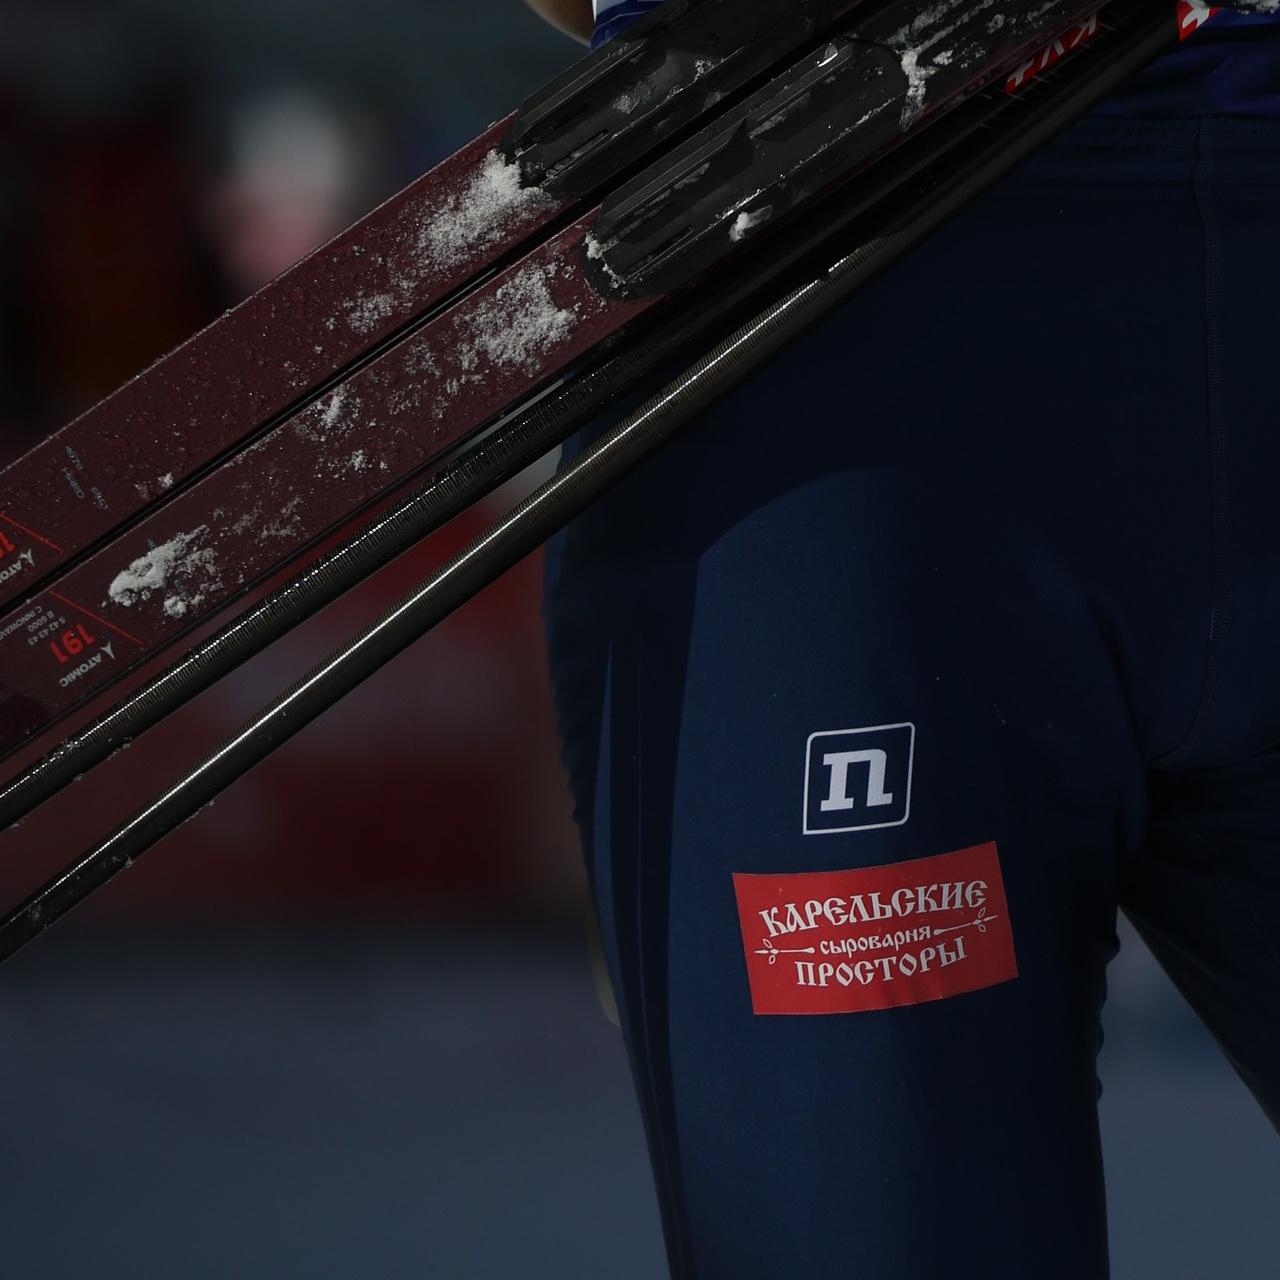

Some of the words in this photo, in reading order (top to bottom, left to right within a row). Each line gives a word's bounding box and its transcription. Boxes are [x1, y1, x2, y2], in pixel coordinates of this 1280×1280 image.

[26, 614, 48, 633] 6000
[26, 634, 39, 645] 43
[36, 627, 49, 639] 43
[47, 619, 60, 631] 42
[47, 622, 95, 664] 191
[58, 652, 101, 688] ATOMIC
[759, 880, 988, 938] КАРЕЛЬСКИЕ
[819, 925, 932, 957] сыроварня
[795, 936, 967, 987] ПРОСТОРЫ
